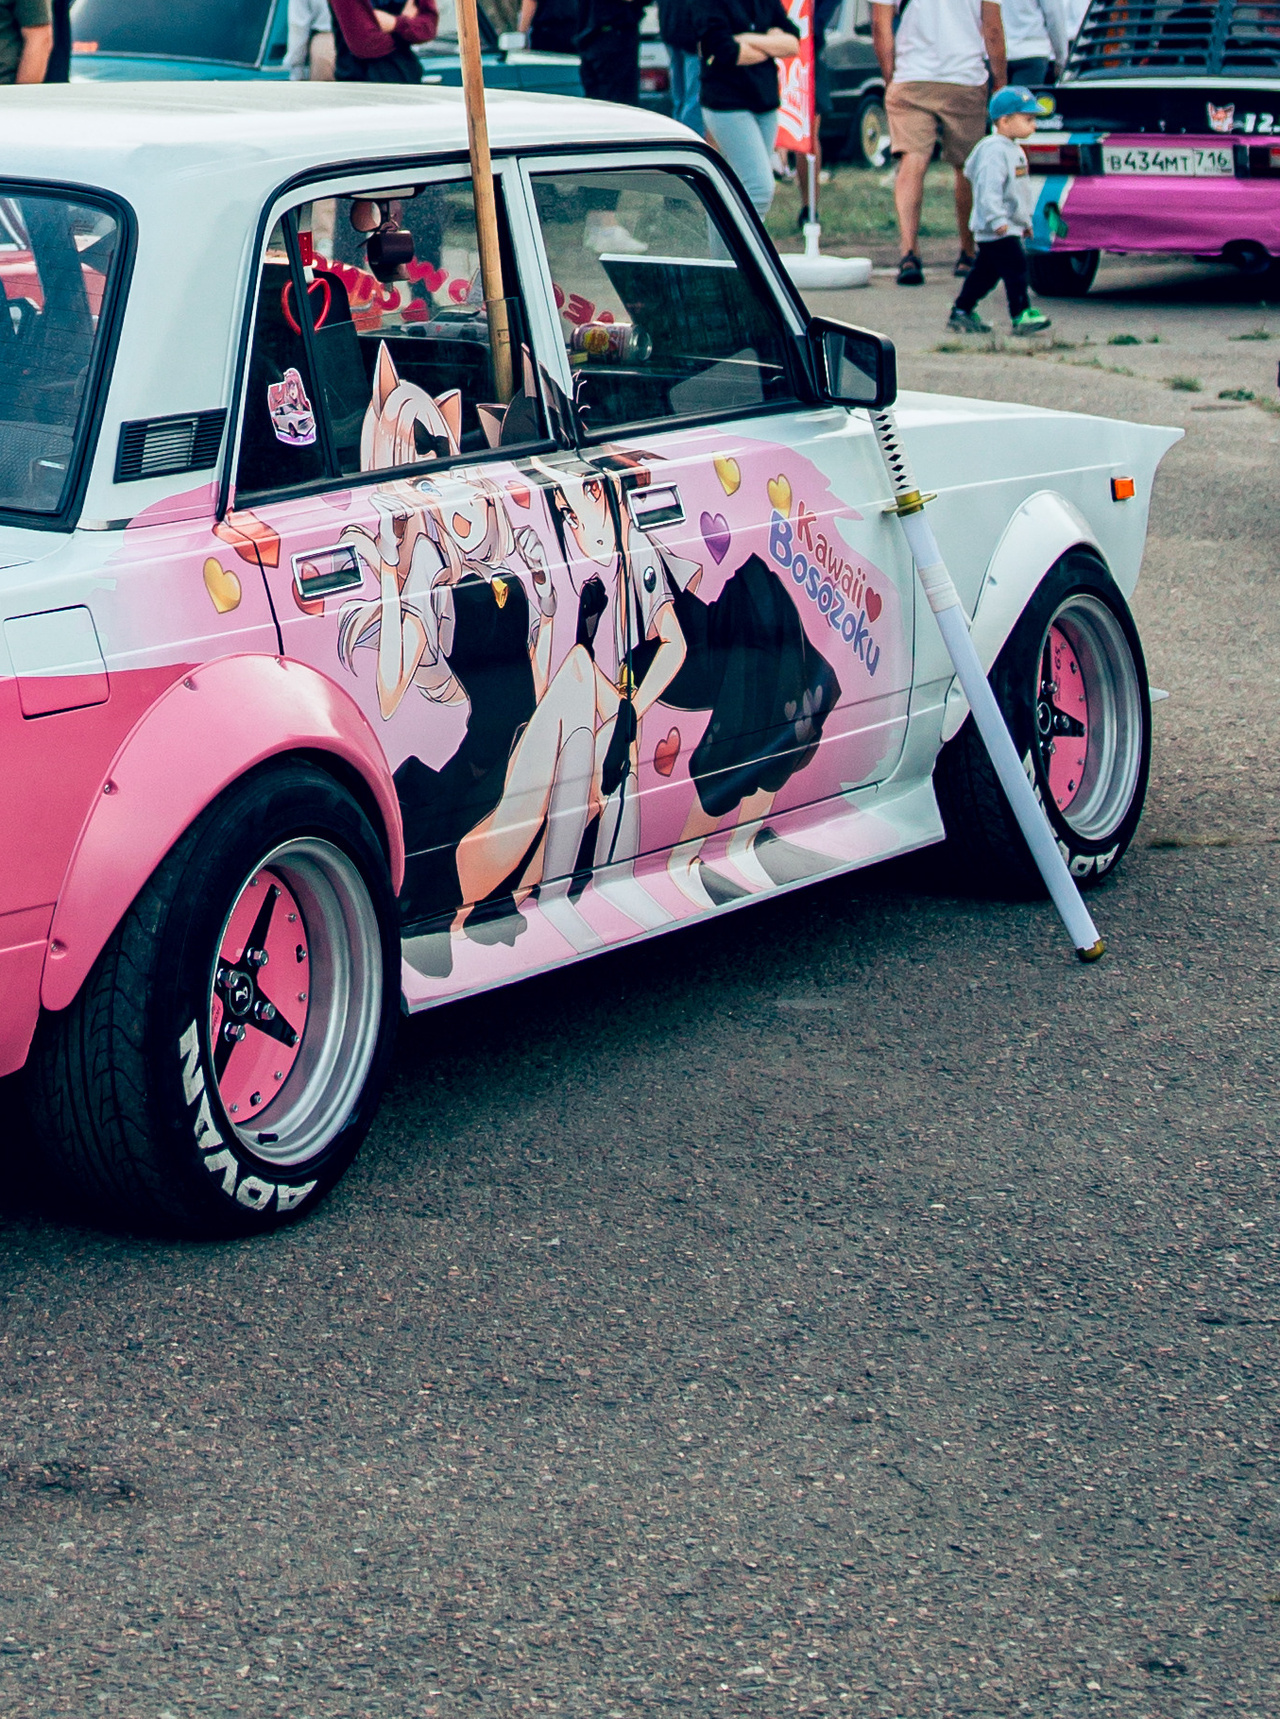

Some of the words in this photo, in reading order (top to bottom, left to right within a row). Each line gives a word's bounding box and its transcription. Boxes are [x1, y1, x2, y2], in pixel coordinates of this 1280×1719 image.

[769, 508, 881, 679] Bosozoku
[796, 499, 867, 610] Kawaii
[178, 1018, 318, 1213] ADVAN
